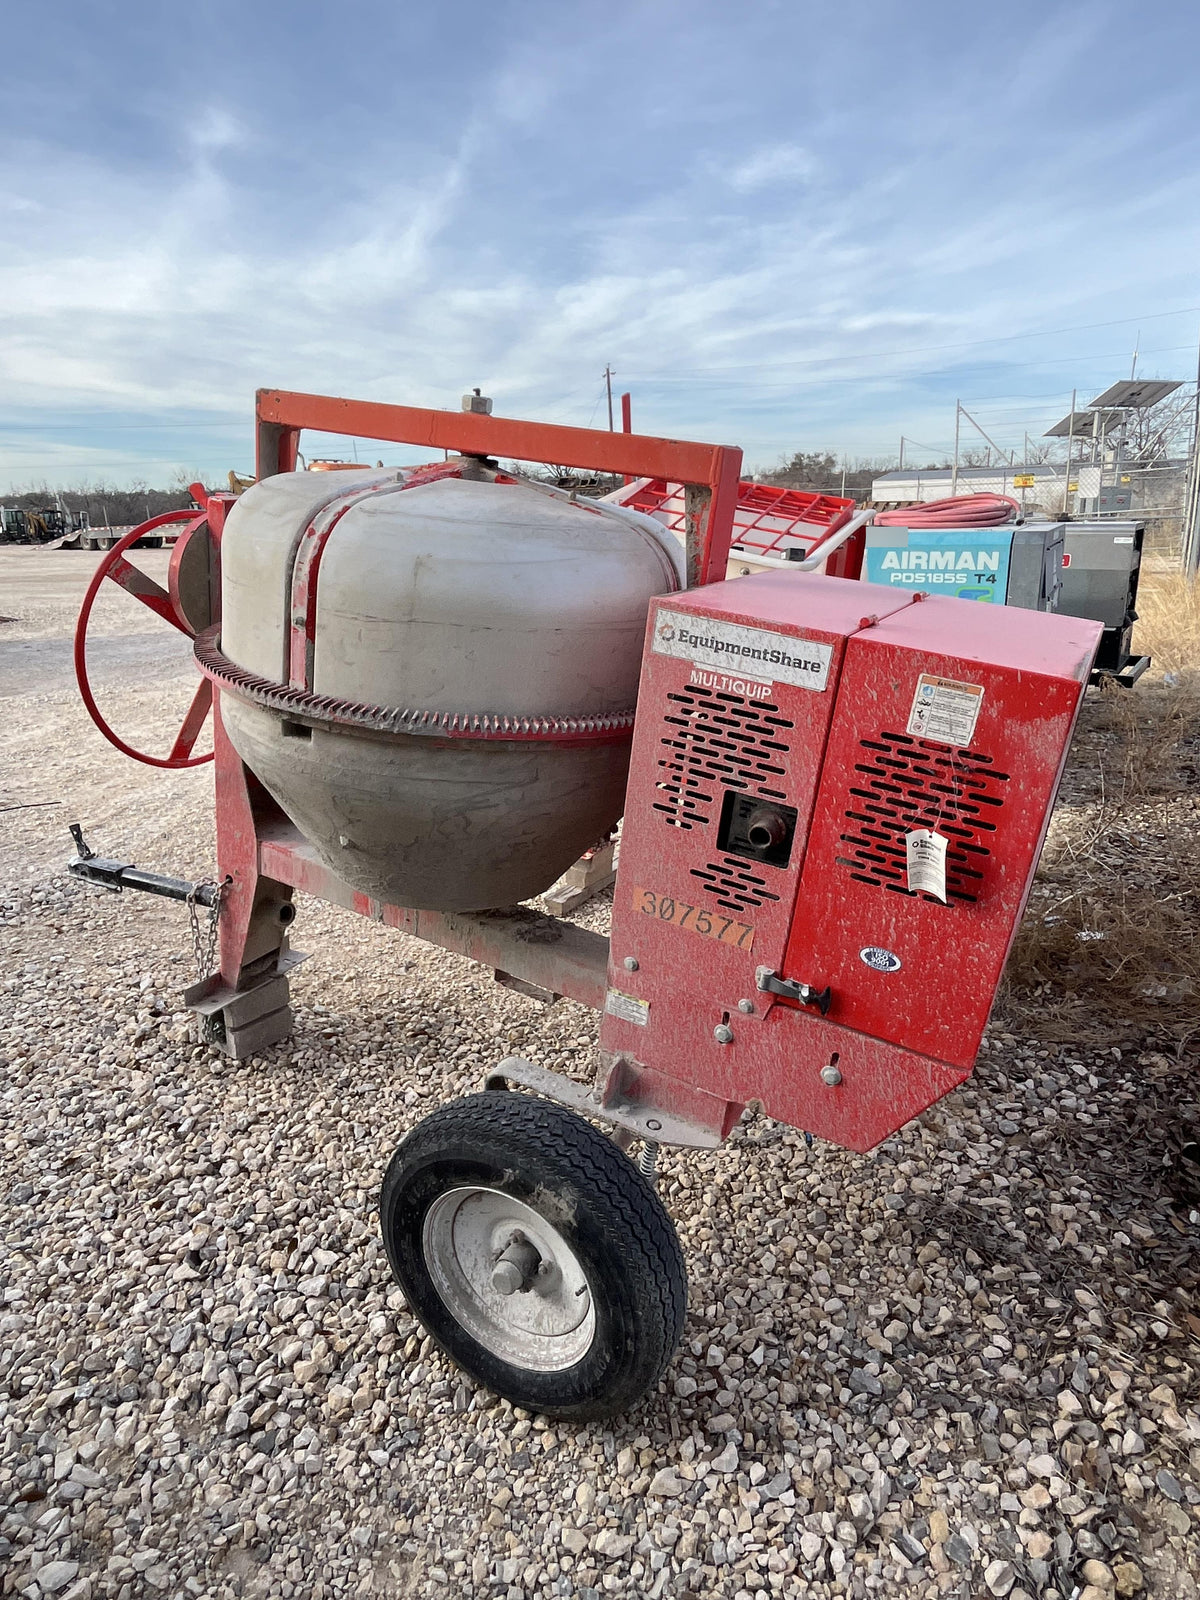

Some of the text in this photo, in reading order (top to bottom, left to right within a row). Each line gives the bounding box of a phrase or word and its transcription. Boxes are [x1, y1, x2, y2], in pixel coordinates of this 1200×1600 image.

[881, 551, 999, 571] AIRMAN
[890, 572, 997, 584] PDS185S T4
[678, 628, 821, 673] EquipmentShare
[690, 670, 772, 700] MULTIQUIP
[641, 891, 754, 947] 307577
